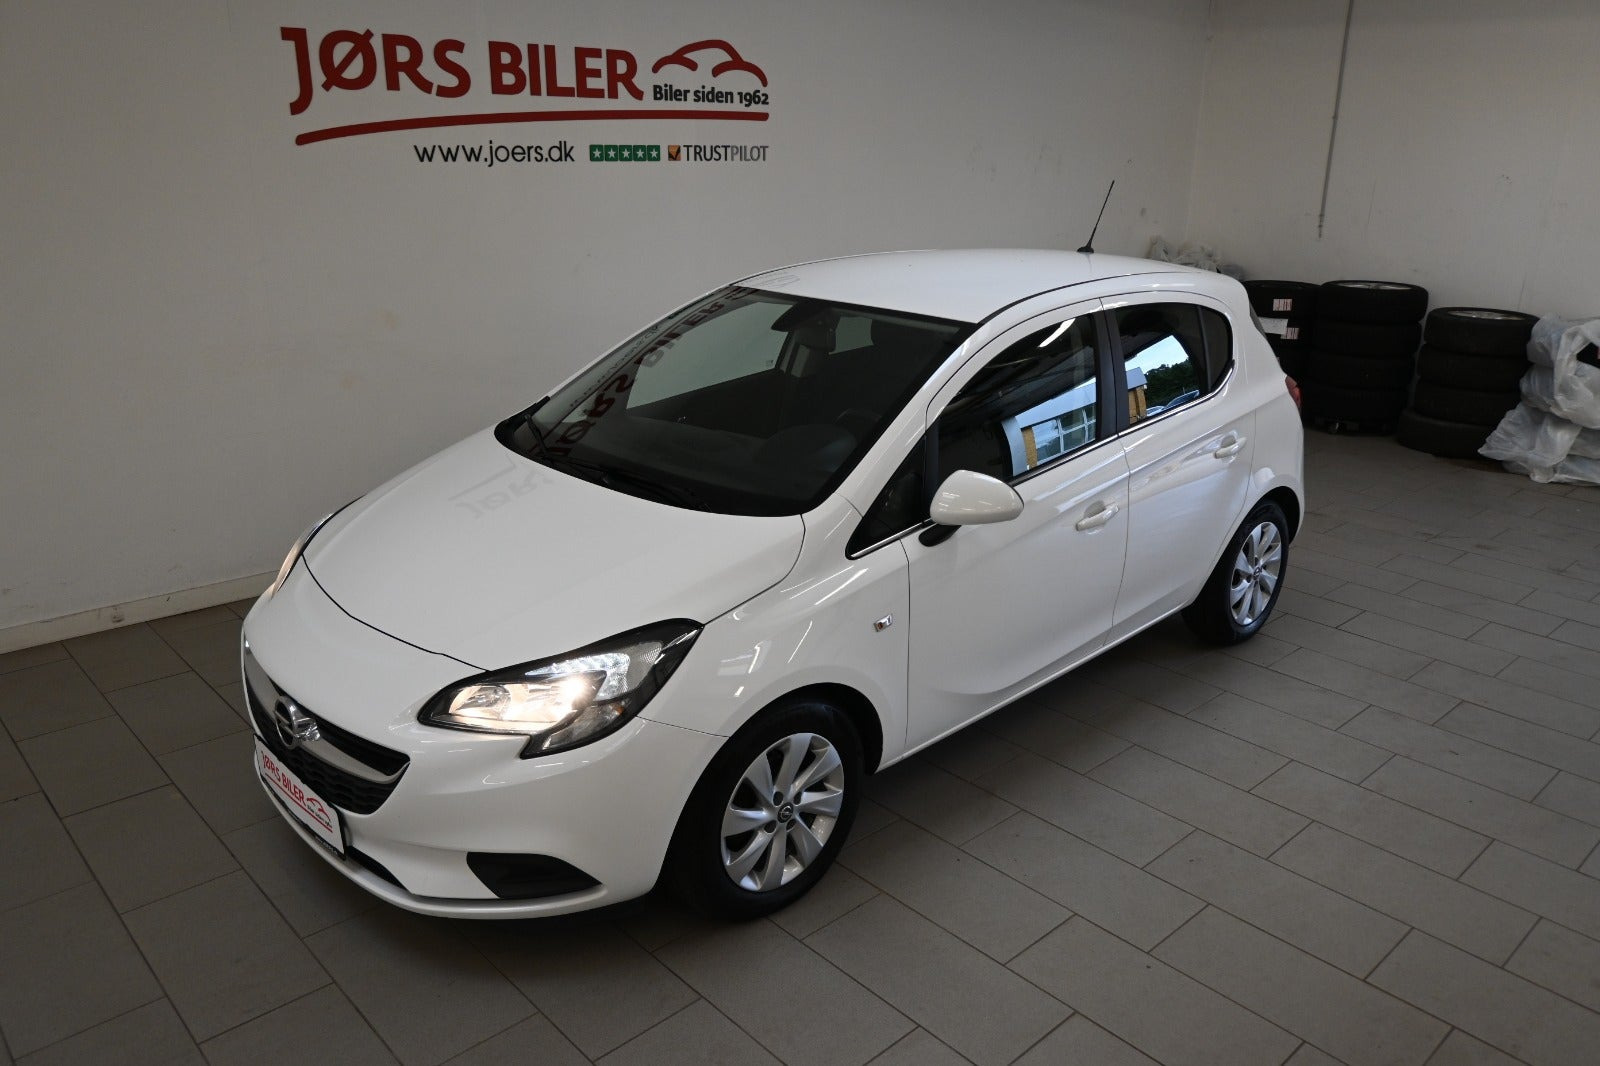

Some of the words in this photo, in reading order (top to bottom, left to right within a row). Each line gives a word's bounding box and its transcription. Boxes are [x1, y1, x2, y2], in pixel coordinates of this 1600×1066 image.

[281, 26, 471, 115] JØRS
[488, 40, 644, 100] BILER
[653, 83, 691, 102] Biler
[693, 85, 734, 104] siden
[737, 89, 770, 108] 1962
[413, 140, 576, 168] www.joers.dk
[683, 144, 770, 162] TRUSTPILOT
[282, 772, 307, 807] BILER
